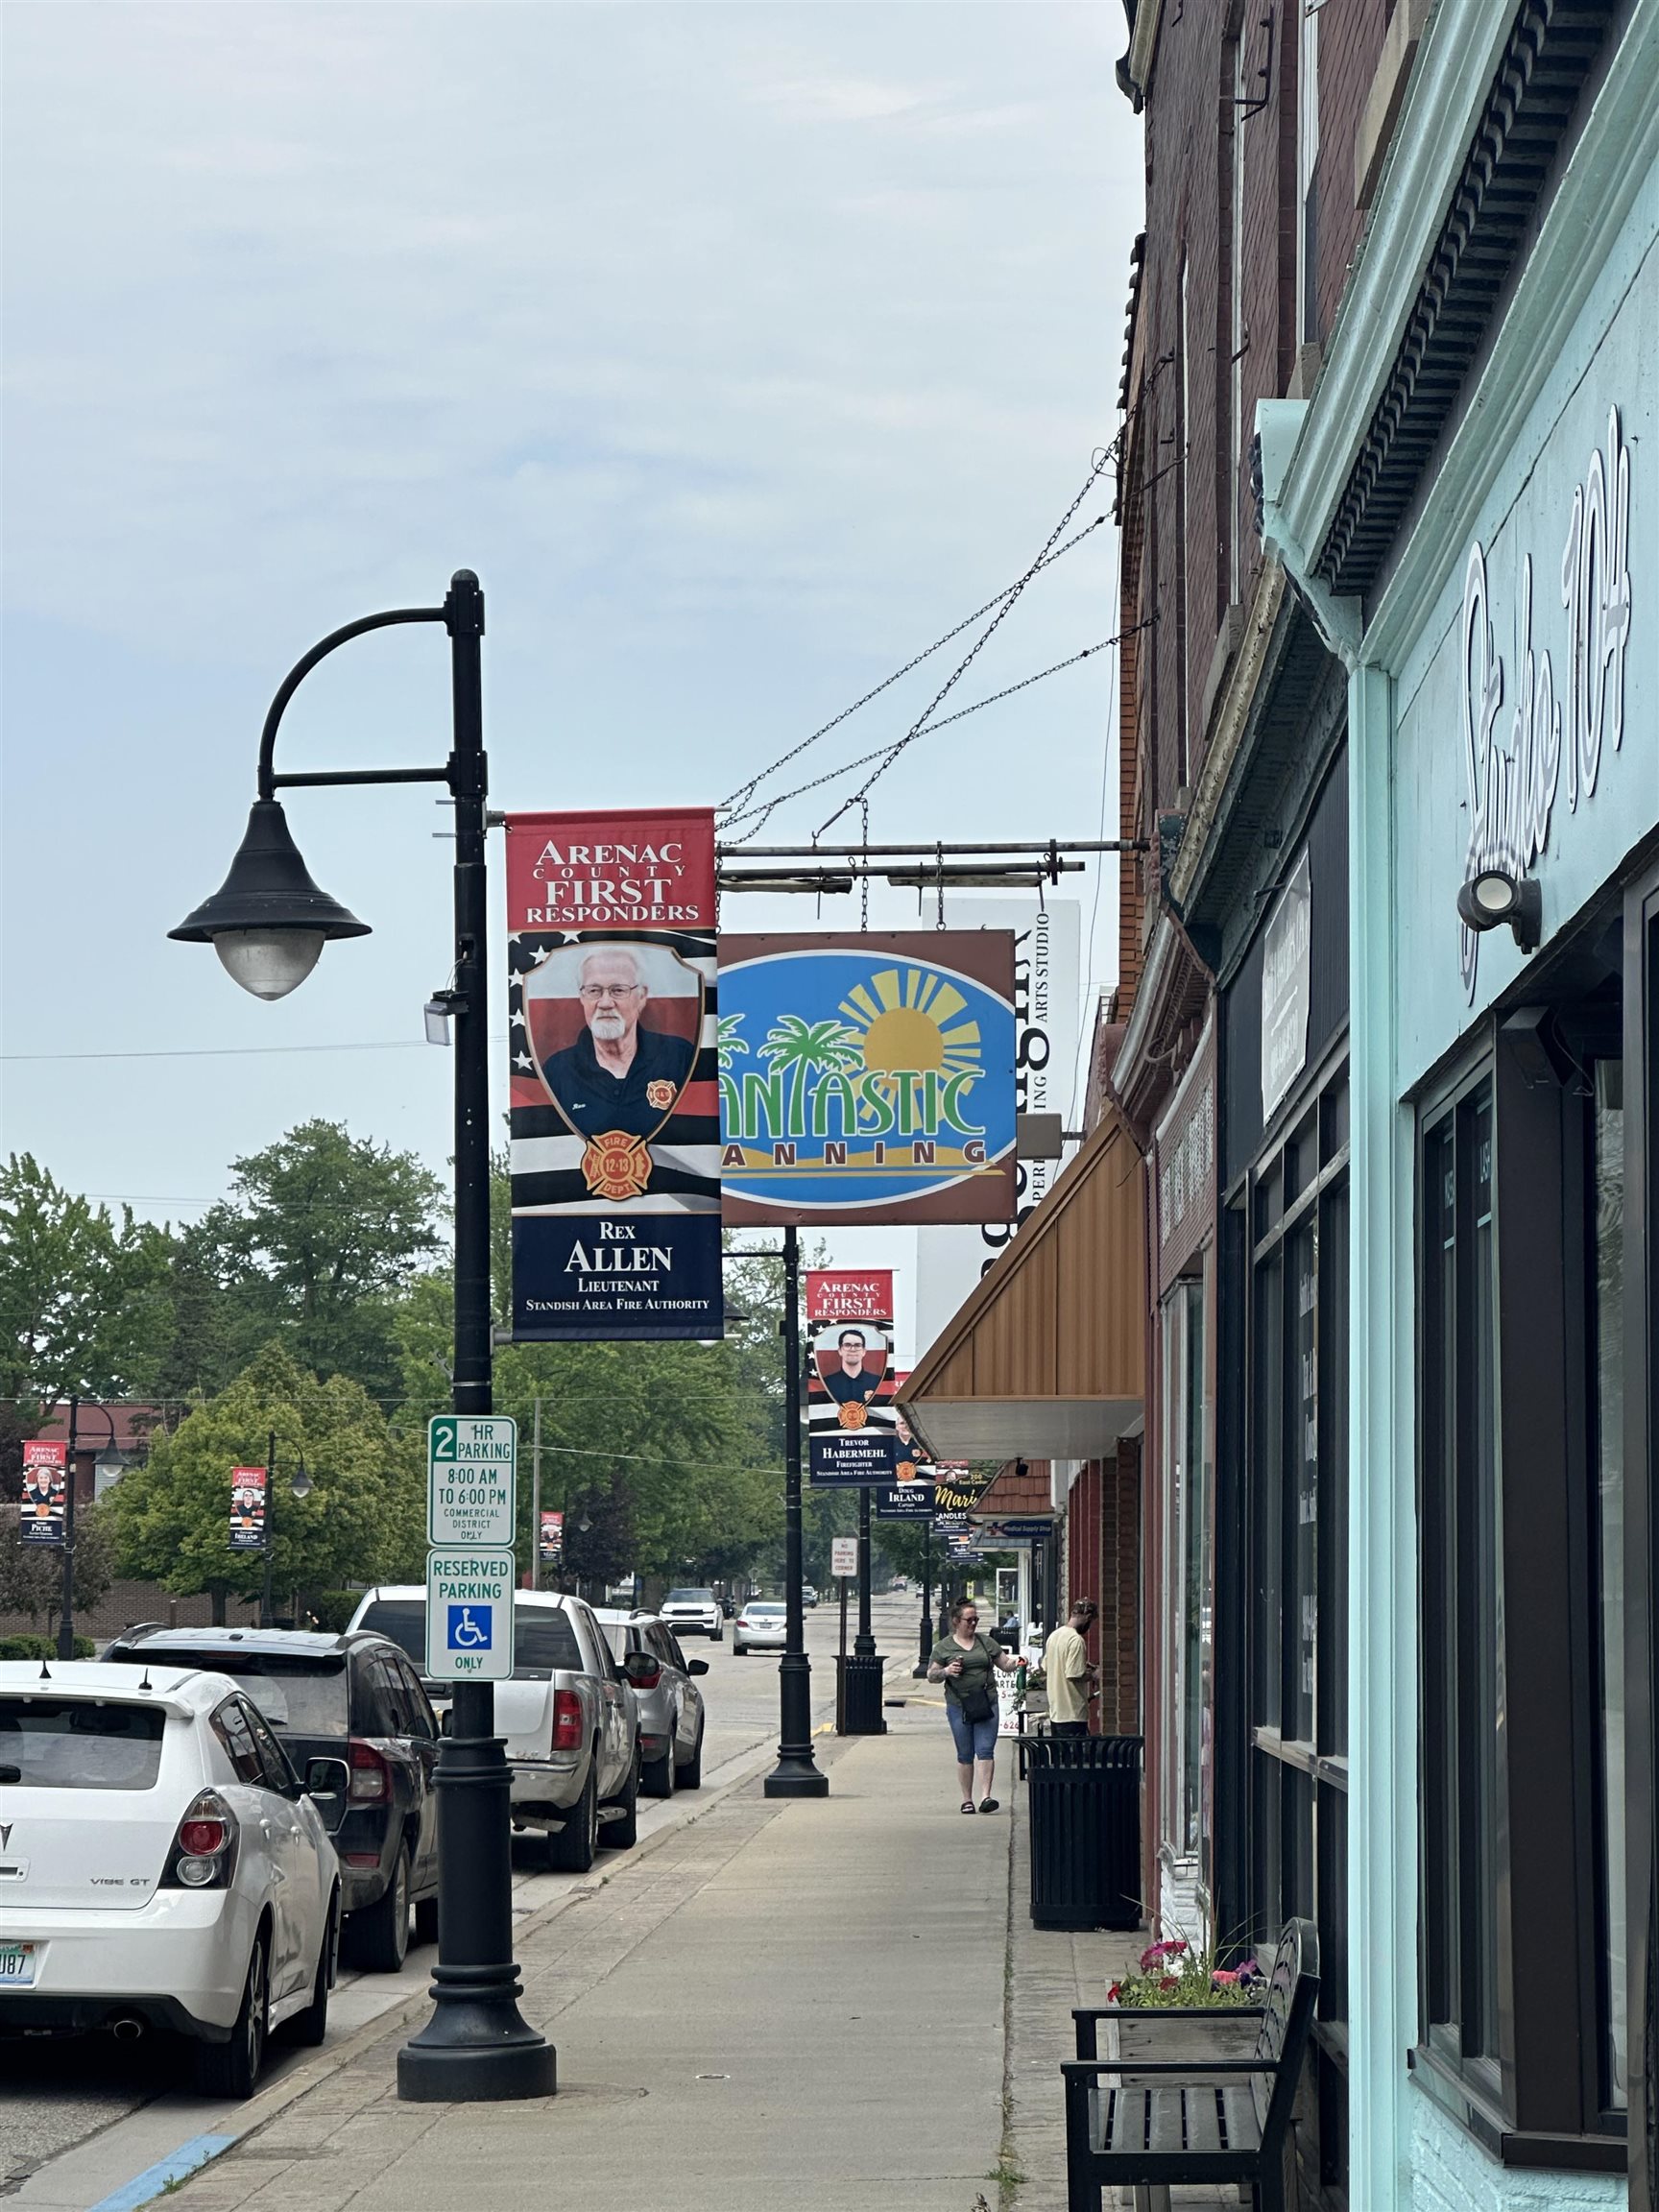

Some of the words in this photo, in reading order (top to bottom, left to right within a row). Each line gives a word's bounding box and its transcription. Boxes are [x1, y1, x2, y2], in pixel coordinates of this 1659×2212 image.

[1562, 402, 1631, 814] 104
[536, 839, 683, 865] ARENAC
[533, 865, 685, 879] COUNTY
[545, 878, 672, 905] FIRST
[526, 904, 700, 924] RESPONDERS
[1036, 913, 1049, 977] STUDIO
[1035, 981, 1048, 1022] ARTS
[718, 1070, 986, 1140] ANTASTIC
[604, 1137, 629, 1147] FIRE
[1032, 1075, 1046, 1201] PERING
[722, 1140, 986, 1167] ANNING
[599, 1221, 636, 1239] REX
[564, 1239, 674, 1272] ALLEN
[578, 1278, 660, 1292] LIEUTENANT
[818, 1282, 880, 1292] ARENAC
[526, 1299, 580, 1310] STANDISH
[582, 1299, 613, 1310] AREA
[616, 1299, 642, 1310] FIRE
[645, 1298, 709, 1310] AUTHORITY
[823, 1298, 876, 1310] FIRST
[473, 1425, 493, 1440] HR
[435, 1426, 453, 1457] 2
[458, 1443, 511, 1459] PARKING
[823, 1448, 887, 1459] HABERMEHL
[448, 1468, 474, 1484] 8:00
[479, 1469, 497, 1484] AM
[439, 1489, 454, 1504] TO
[458, 1489, 485, 1504] 6:00
[489, 1489, 506, 1505] PM
[444, 1508, 499, 1518] COMMERCIAL
[452, 1520, 491, 1528] DISTRICT
[461, 1531, 482, 1540] ONLY
[434, 1561, 509, 1576] RESERVED
[439, 1583, 501, 1599] PARKING
[455, 1657, 483, 1670] ONLY
